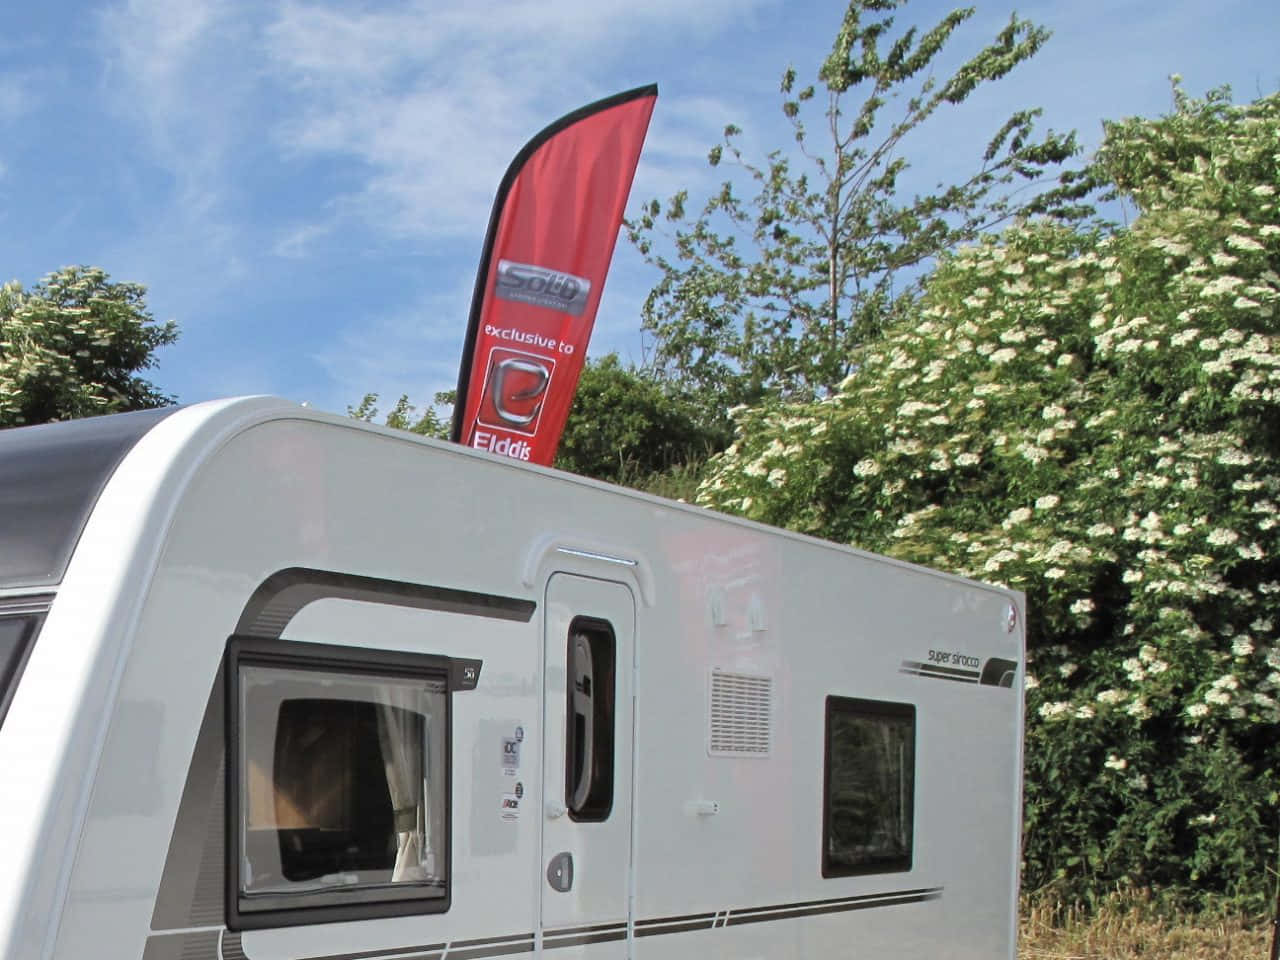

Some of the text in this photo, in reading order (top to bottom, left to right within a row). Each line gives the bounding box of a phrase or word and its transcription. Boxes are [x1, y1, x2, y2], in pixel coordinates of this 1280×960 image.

[485, 324, 574, 354] exclusive to
[473, 431, 532, 461] Elddis
